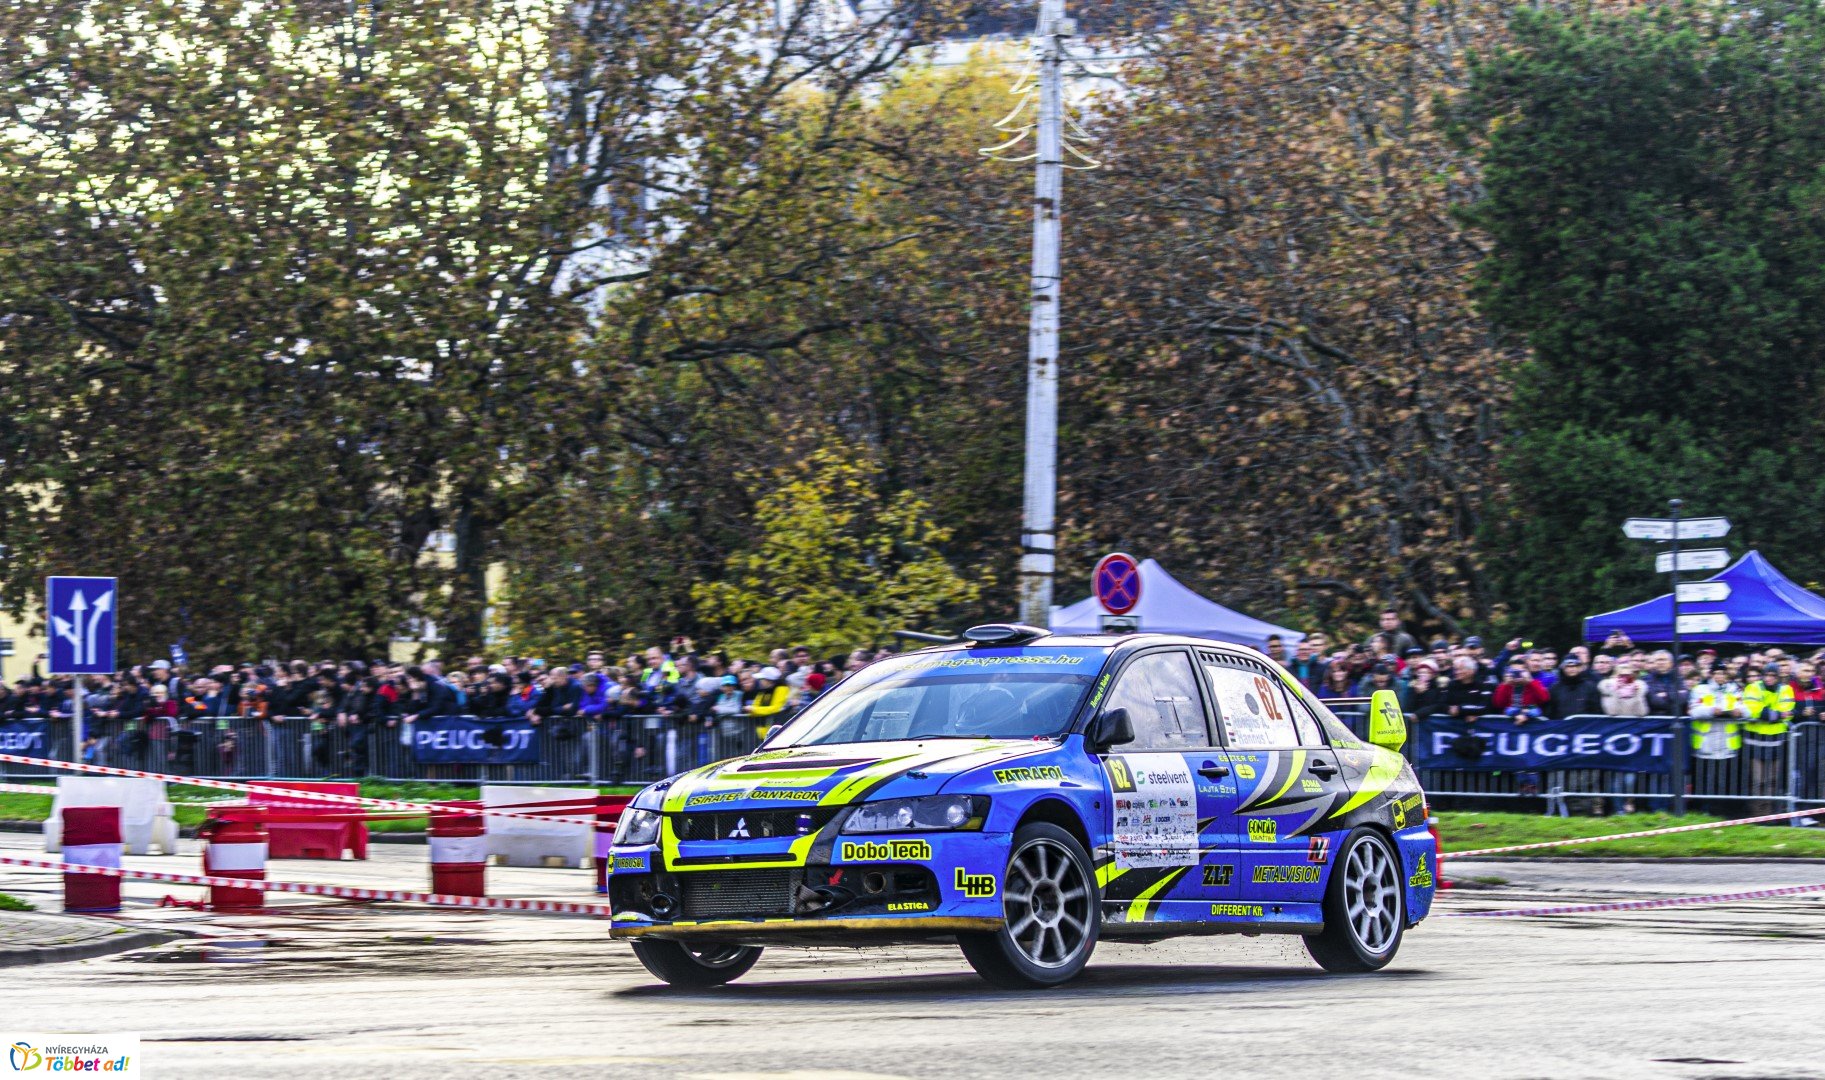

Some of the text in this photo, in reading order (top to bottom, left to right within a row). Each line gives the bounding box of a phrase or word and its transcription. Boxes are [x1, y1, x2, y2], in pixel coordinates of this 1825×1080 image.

[1253, 676, 1284, 721] 62
[415, 728, 536, 750] PEUGOT
[993, 766, 1068, 784] FATRAFOL
[1108, 758, 1132, 789] 62
[1148, 770, 1189, 785] steelvent
[687, 789, 823, 807] ZSIRAFEPOANYAGOK
[843, 840, 931, 861] DoboTech
[1202, 865, 1235, 887] ZLT
[1252, 865, 1321, 883] METALVISION
[1211, 904, 1251, 916] DIFFERENT
